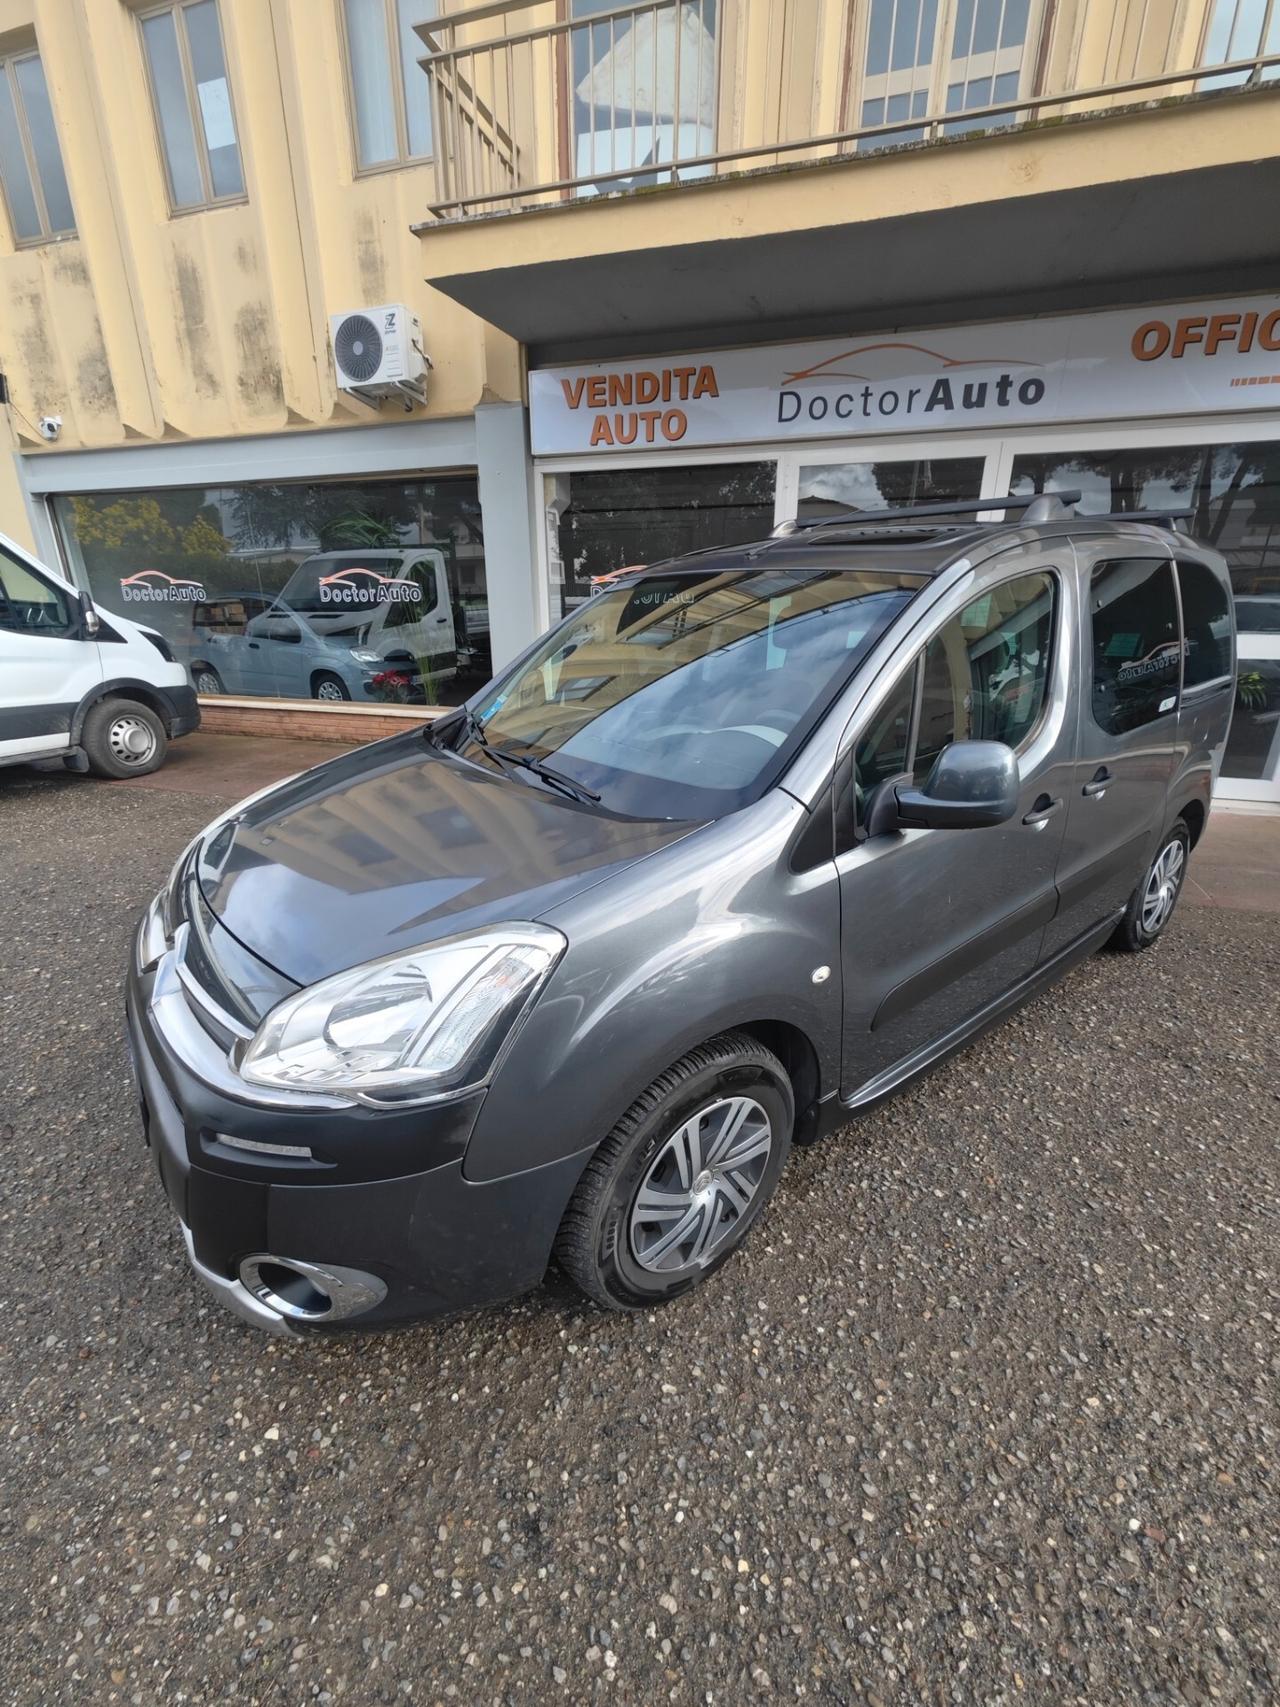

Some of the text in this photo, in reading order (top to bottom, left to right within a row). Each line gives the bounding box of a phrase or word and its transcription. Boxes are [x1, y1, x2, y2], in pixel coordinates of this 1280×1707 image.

[560, 365, 719, 409] VENDITA
[778, 374, 1045, 423] DoctorAuto
[590, 408, 688, 446] AUTO
[121, 586, 207, 602] DoctorAuto
[319, 585, 422, 602] DoctorAuto
